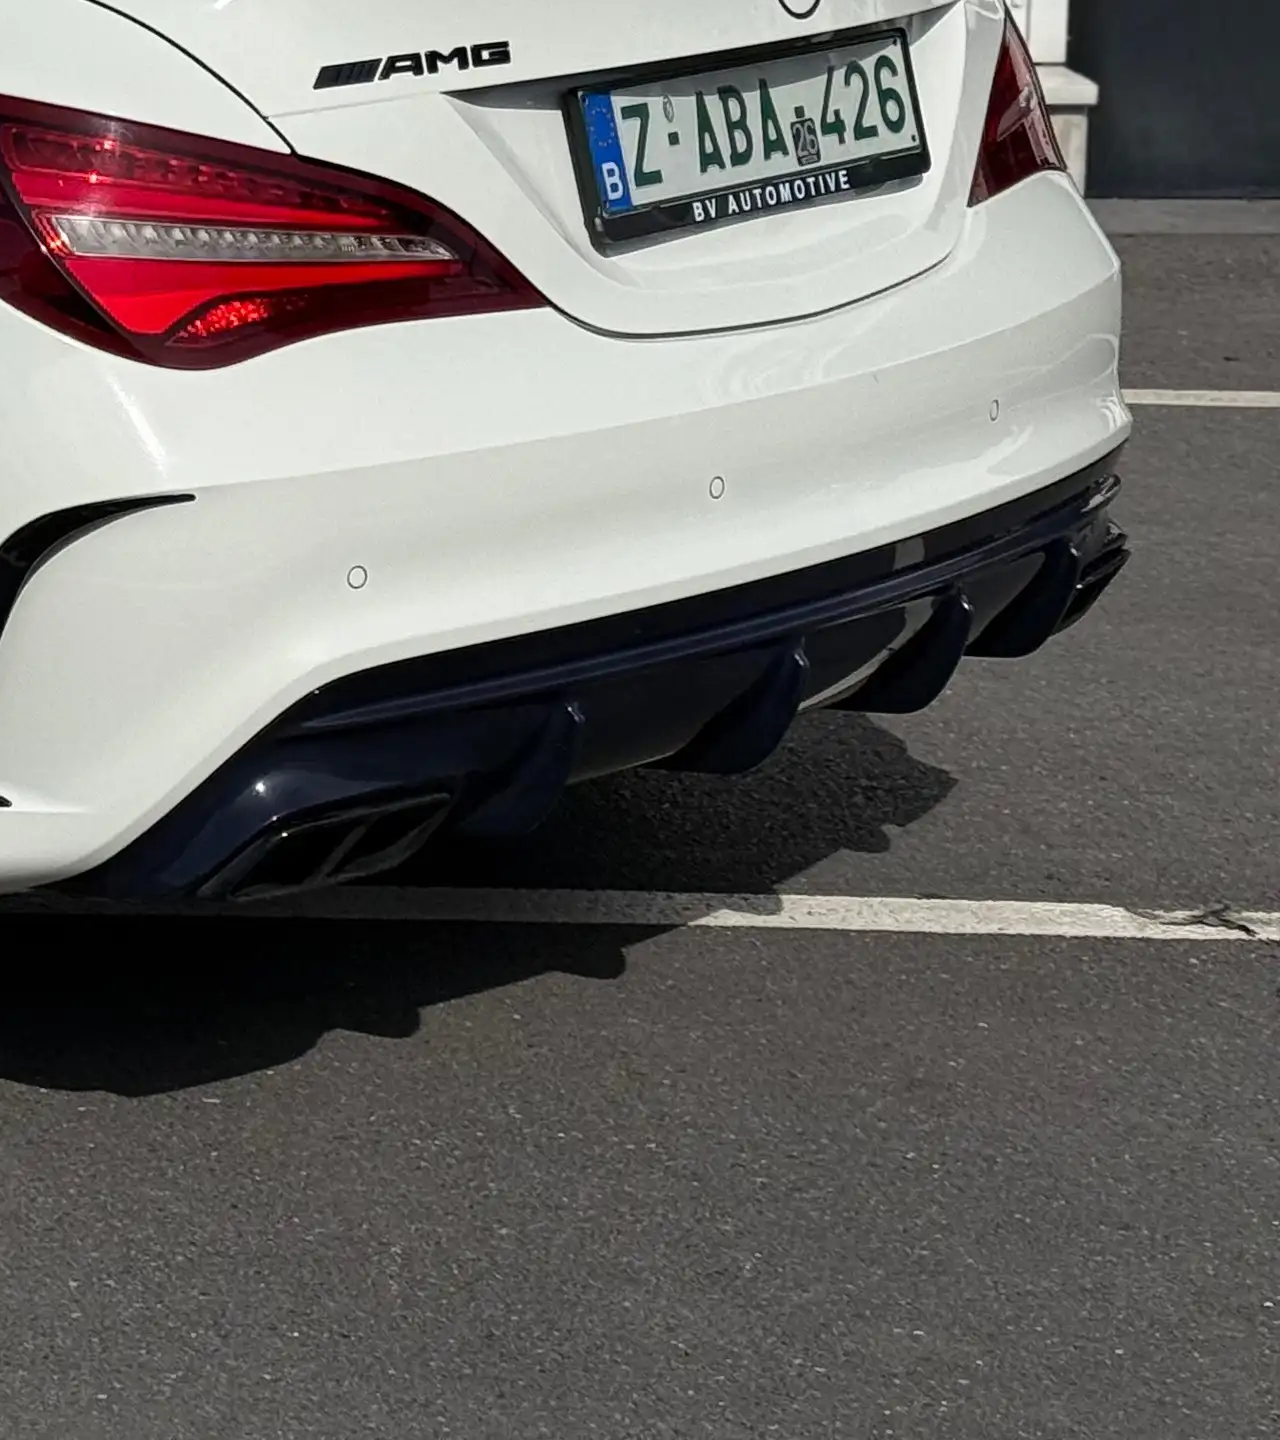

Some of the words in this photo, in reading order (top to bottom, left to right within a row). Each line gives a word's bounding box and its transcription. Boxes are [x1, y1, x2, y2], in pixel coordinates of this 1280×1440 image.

[602, 161, 624, 201] B
[692, 198, 718, 223] BV
[727, 170, 852, 213] AUTOMOTIVE
